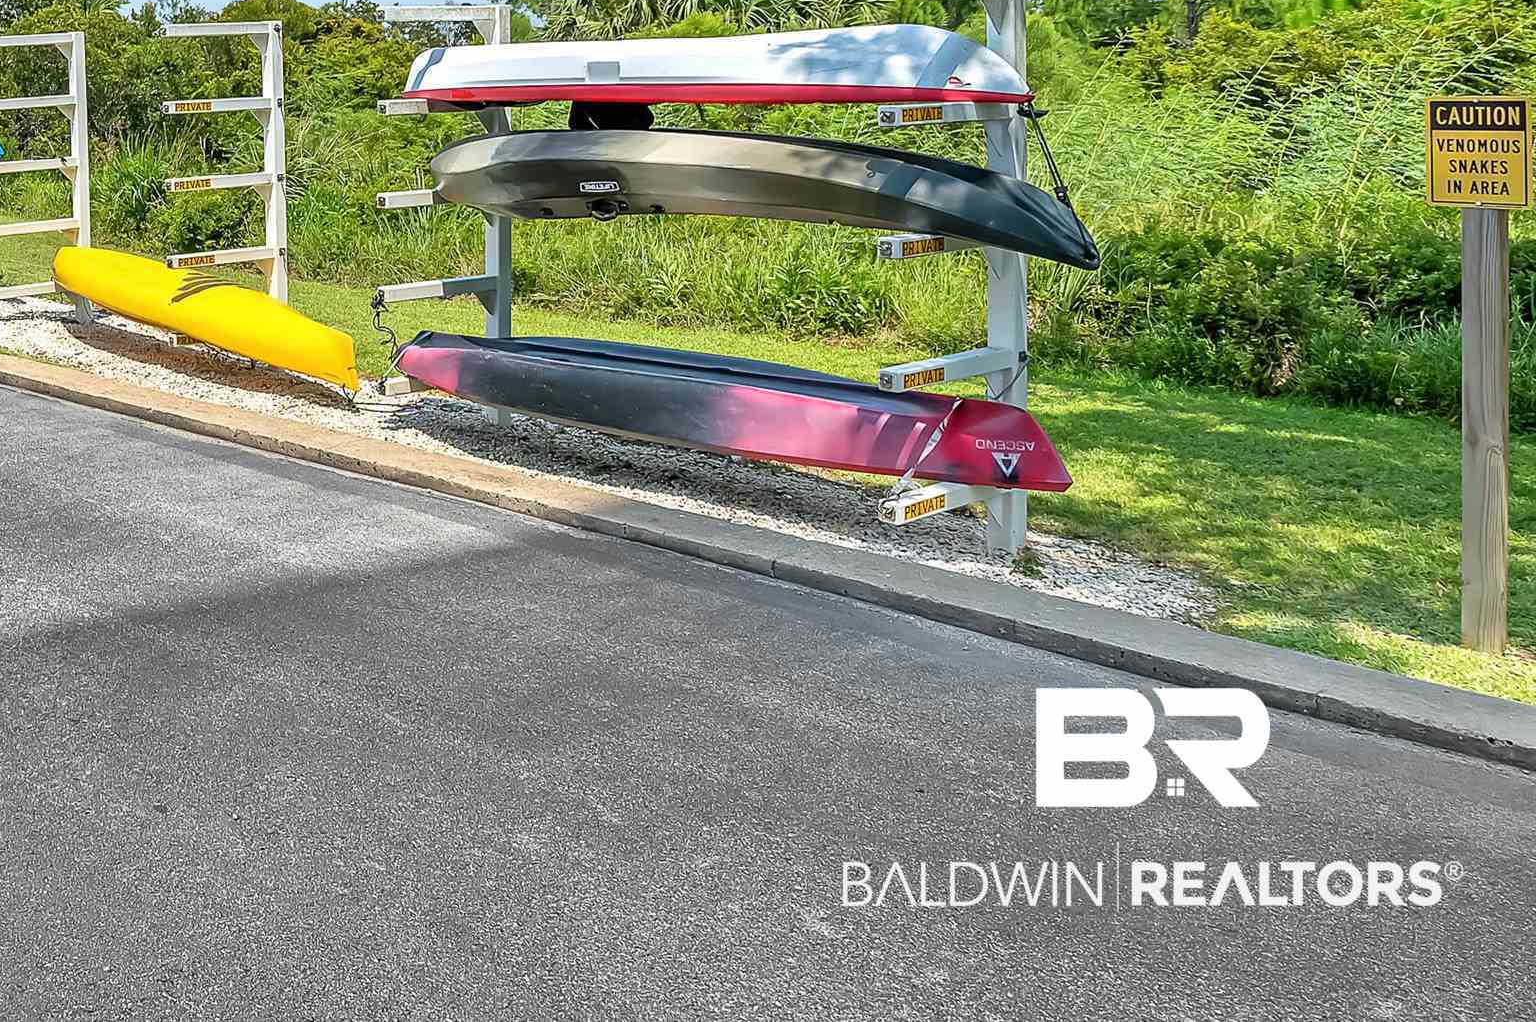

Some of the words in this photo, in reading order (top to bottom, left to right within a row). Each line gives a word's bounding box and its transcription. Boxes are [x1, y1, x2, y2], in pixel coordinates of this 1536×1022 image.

[175, 102, 212, 111] PRIVATE
[903, 106, 943, 122] PRIVATE
[1436, 106, 1521, 126] CAUTION
[1437, 138, 1521, 154] VENOMOUS
[1449, 159, 1509, 175] SNAKES
[174, 179, 211, 190] PRIVATE
[1447, 179, 1462, 194] IN
[1469, 180, 1510, 196] AREA
[178, 255, 215, 266] PRIVATE
[904, 367, 944, 388] PRIVATE
[976, 439, 1035, 451] ASCEND
[904, 495, 944, 520] PRIVATE
